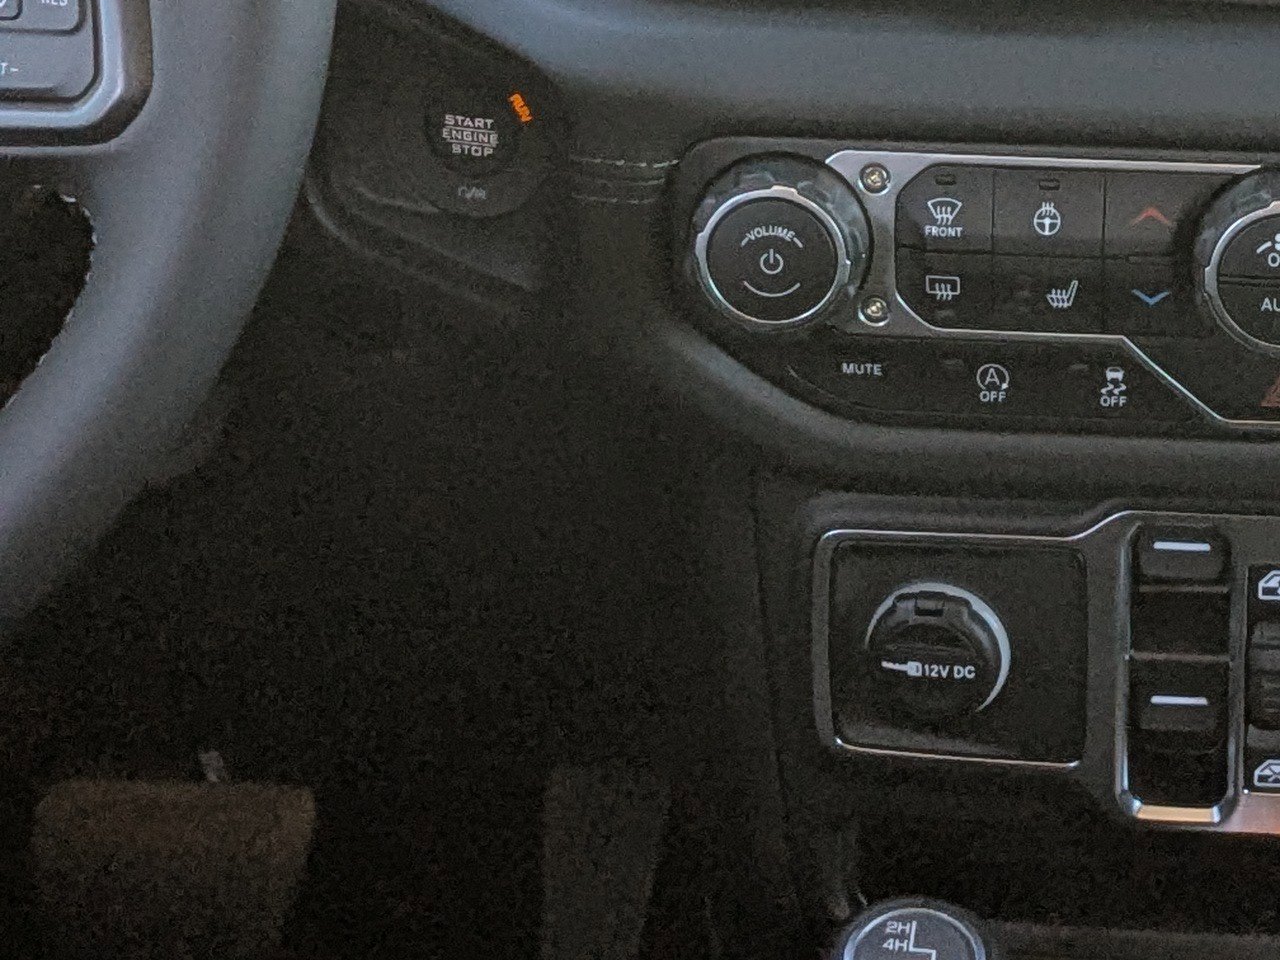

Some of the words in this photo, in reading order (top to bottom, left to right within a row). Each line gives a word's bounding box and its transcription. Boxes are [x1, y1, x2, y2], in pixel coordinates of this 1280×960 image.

[444, 114, 494, 129] START
[442, 128, 499, 146] ENGINE
[452, 143, 494, 157] STOP
[746, 225, 795, 242] VOLUME
[924, 226, 962, 237] FRONT
[842, 363, 882, 376] MUTE
[979, 390, 1007, 403] OFF
[1100, 395, 1127, 407] OFF
[924, 665, 950, 679] 12V
[953, 666, 976, 679] DC
[885, 921, 910, 934] 2H
[882, 938, 909, 951] 4H
